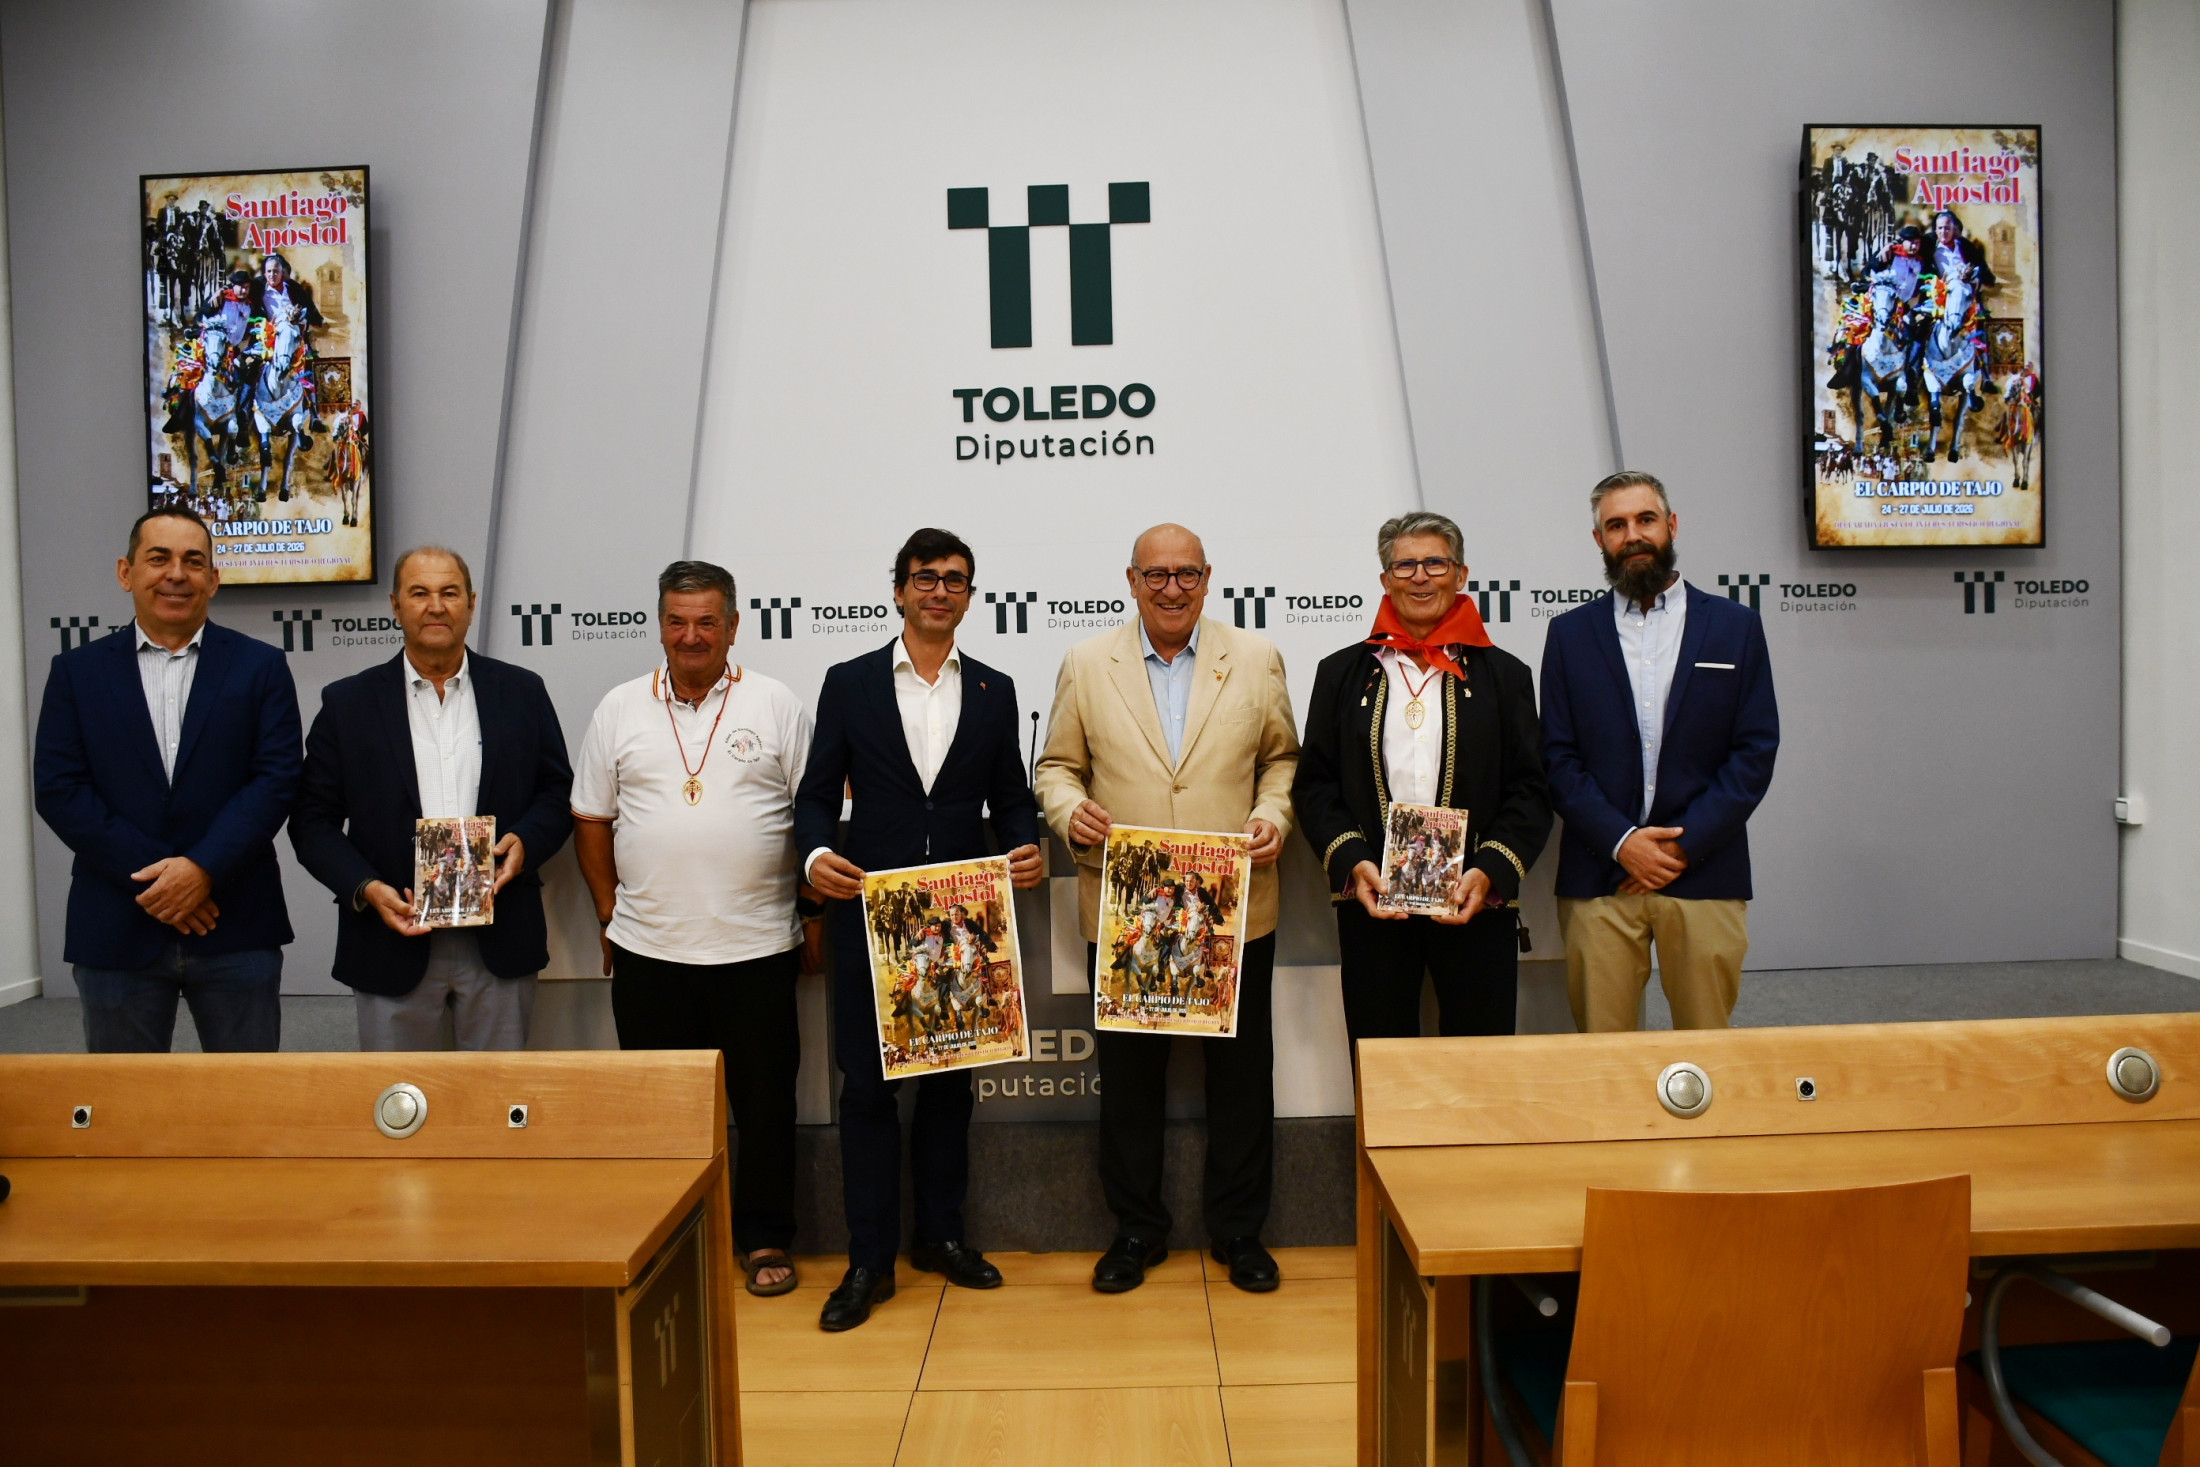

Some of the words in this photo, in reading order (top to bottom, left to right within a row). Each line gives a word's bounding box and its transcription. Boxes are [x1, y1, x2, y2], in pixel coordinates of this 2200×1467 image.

[1895, 147, 2020, 181] Santiago
[1911, 177, 2022, 212] Apóstol
[226, 191, 348, 223] Santiago
[241, 218, 349, 256] Apóstol
[953, 383, 1156, 422] TOLEDO
[956, 430, 1154, 465] Diputación
[1855, 481, 1875, 497] EL
[1877, 481, 1938, 497] CARPIO
[1939, 481, 1961, 496] DE
[1963, 480, 2003, 496] TAJO
[1882, 504, 1891, 514] 24
[1899, 504, 1908, 514] 27
[1910, 504, 1920, 514] DE
[1922, 504, 1942, 514] JULIO
[1943, 504, 1954, 514] DE
[211, 520, 269, 536] CARPIO
[272, 520, 292, 535] DE
[295, 518, 332, 534] TAJO
[216, 544, 226, 554] 24
[234, 544, 242, 553] 27
[244, 543, 253, 553] DE
[255, 543, 274, 553] JULIO
[276, 542, 286, 552] DE
[1780, 583, 1856, 598] TOLEDO
[2015, 580, 2089, 595] TOLEDO
[1047, 600, 1125, 614] TOLEDO
[1285, 594, 1363, 610] TOLEDO
[1780, 600, 1856, 613] Diputación
[2015, 596, 2089, 609] Diputación
[572, 611, 647, 627] TOLEDO
[811, 604, 888, 620] TOLEDO
[1286, 611, 1363, 625] Diputación
[812, 622, 888, 635] Diputación
[1048, 616, 1124, 629] Diputación
[572, 628, 647, 641] Diputación
[1159, 839, 1236, 861] Santiago
[1167, 856, 1234, 877] Apóstol
[917, 870, 995, 892] Santiago
[930, 884, 996, 911] Apóstol
[1135, 995, 1170, 1004] CARPIO
[1172, 996, 1185, 1005] DE
[1186, 997, 1210, 1006] TAJO
[923, 1032, 959, 1045] CARPIO
[960, 1030, 973, 1039] DE
[974, 1026, 998, 1037] TAJO
